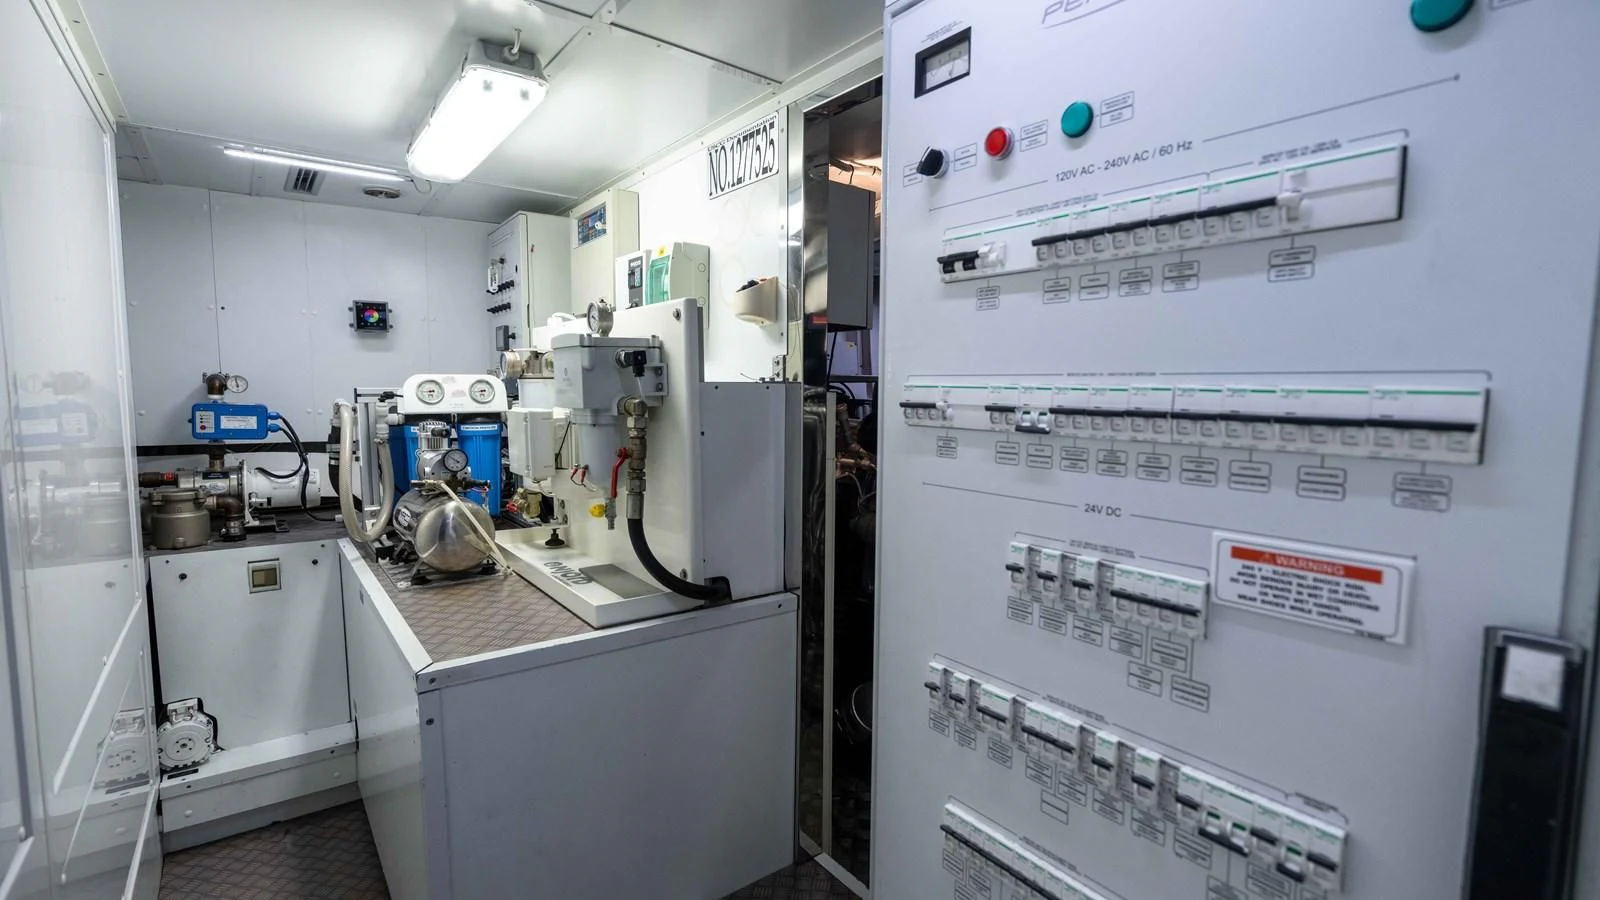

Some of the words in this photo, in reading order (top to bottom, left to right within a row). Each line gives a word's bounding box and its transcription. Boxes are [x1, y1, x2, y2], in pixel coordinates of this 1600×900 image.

[726, 115, 777, 143] Documentation
[708, 120, 776, 197] NO.1277525
[1055, 167, 1079, 182] 120V
[1079, 164, 1096, 177] AC
[1103, 155, 1131, 171] 240V
[1132, 150, 1150, 164] AC
[1159, 143, 1174, 157] 60
[1176, 140, 1193, 153] Hz
[1084, 503, 1104, 515] 24V
[1105, 506, 1122, 518] DC
[1275, 555, 1345, 576] WARNING
